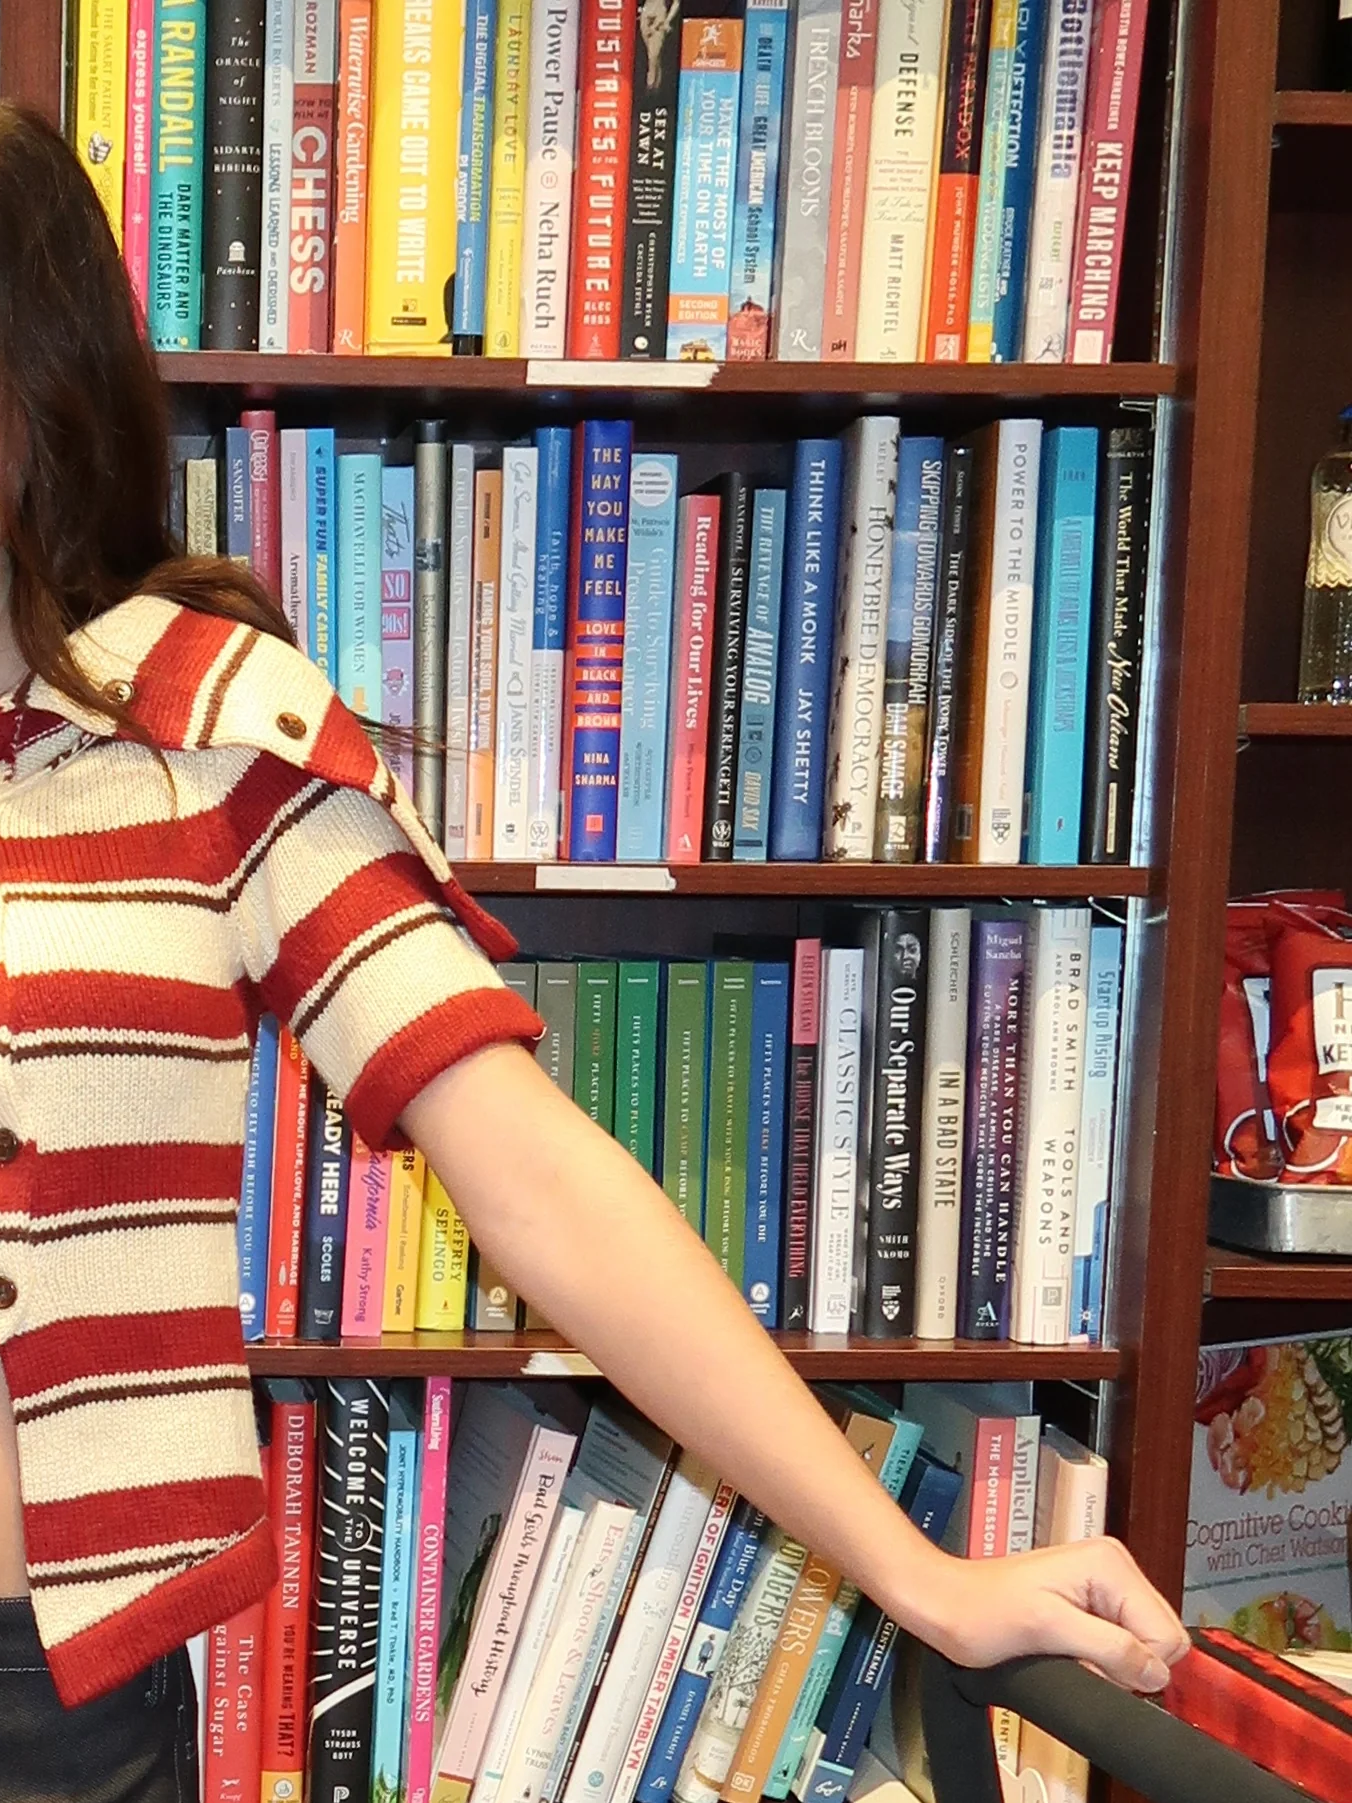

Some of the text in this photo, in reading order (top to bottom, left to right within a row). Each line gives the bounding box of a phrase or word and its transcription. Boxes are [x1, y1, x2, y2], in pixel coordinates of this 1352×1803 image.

[158, 21, 195, 173] RANDALL
[340, 17, 366, 223] Waterwise Gardening
[541, 9, 567, 160] Power Pause
[290, 126, 327, 294] CHESS
[396, 71, 430, 283] CAME OUT TO WRITE
[1079, 142, 1123, 320] KEEP MARCHING
[156, 193, 173, 311] THE DINOSAURS
[175, 184, 192, 319] DARK MATTER AND
[534, 201, 560, 330] Neha Ruch
[883, 277, 902, 334] RICHTEL
[887, 234, 904, 272] MATT
[587, 500, 623, 516] YOU
[591, 473, 621, 489] WAY
[592, 448, 622, 463] THE
[584, 527, 625, 542] MAKE
[584, 579, 622, 596] FEEL
[594, 554, 615, 569] ME
[800, 460, 825, 664] THINK LIKE A MONK
[685, 516, 711, 729] Reading for Our Lives
[793, 689, 813, 804] JAY SHETTY
[880, 703, 908, 799] DAN SAVAGE
[1063, 953, 1082, 1092] BRAD SMITH
[877, 987, 916, 1209] Our Separate Ways
[934, 1071, 959, 1208] IN A BAD STATE
[319, 1236, 333, 1282] SCOLES
[283, 1415, 304, 1608] DEBORAH TANNEN
[337, 1399, 369, 1669] WELCOME TO THE UNIVERSE
[1187, 1511, 1284, 1549] Cognitive
[235, 1635, 254, 1732] The Case
[414, 1524, 440, 1721] CONTAINER GARDENS
[210, 1625, 229, 1757] gainst Sugar
